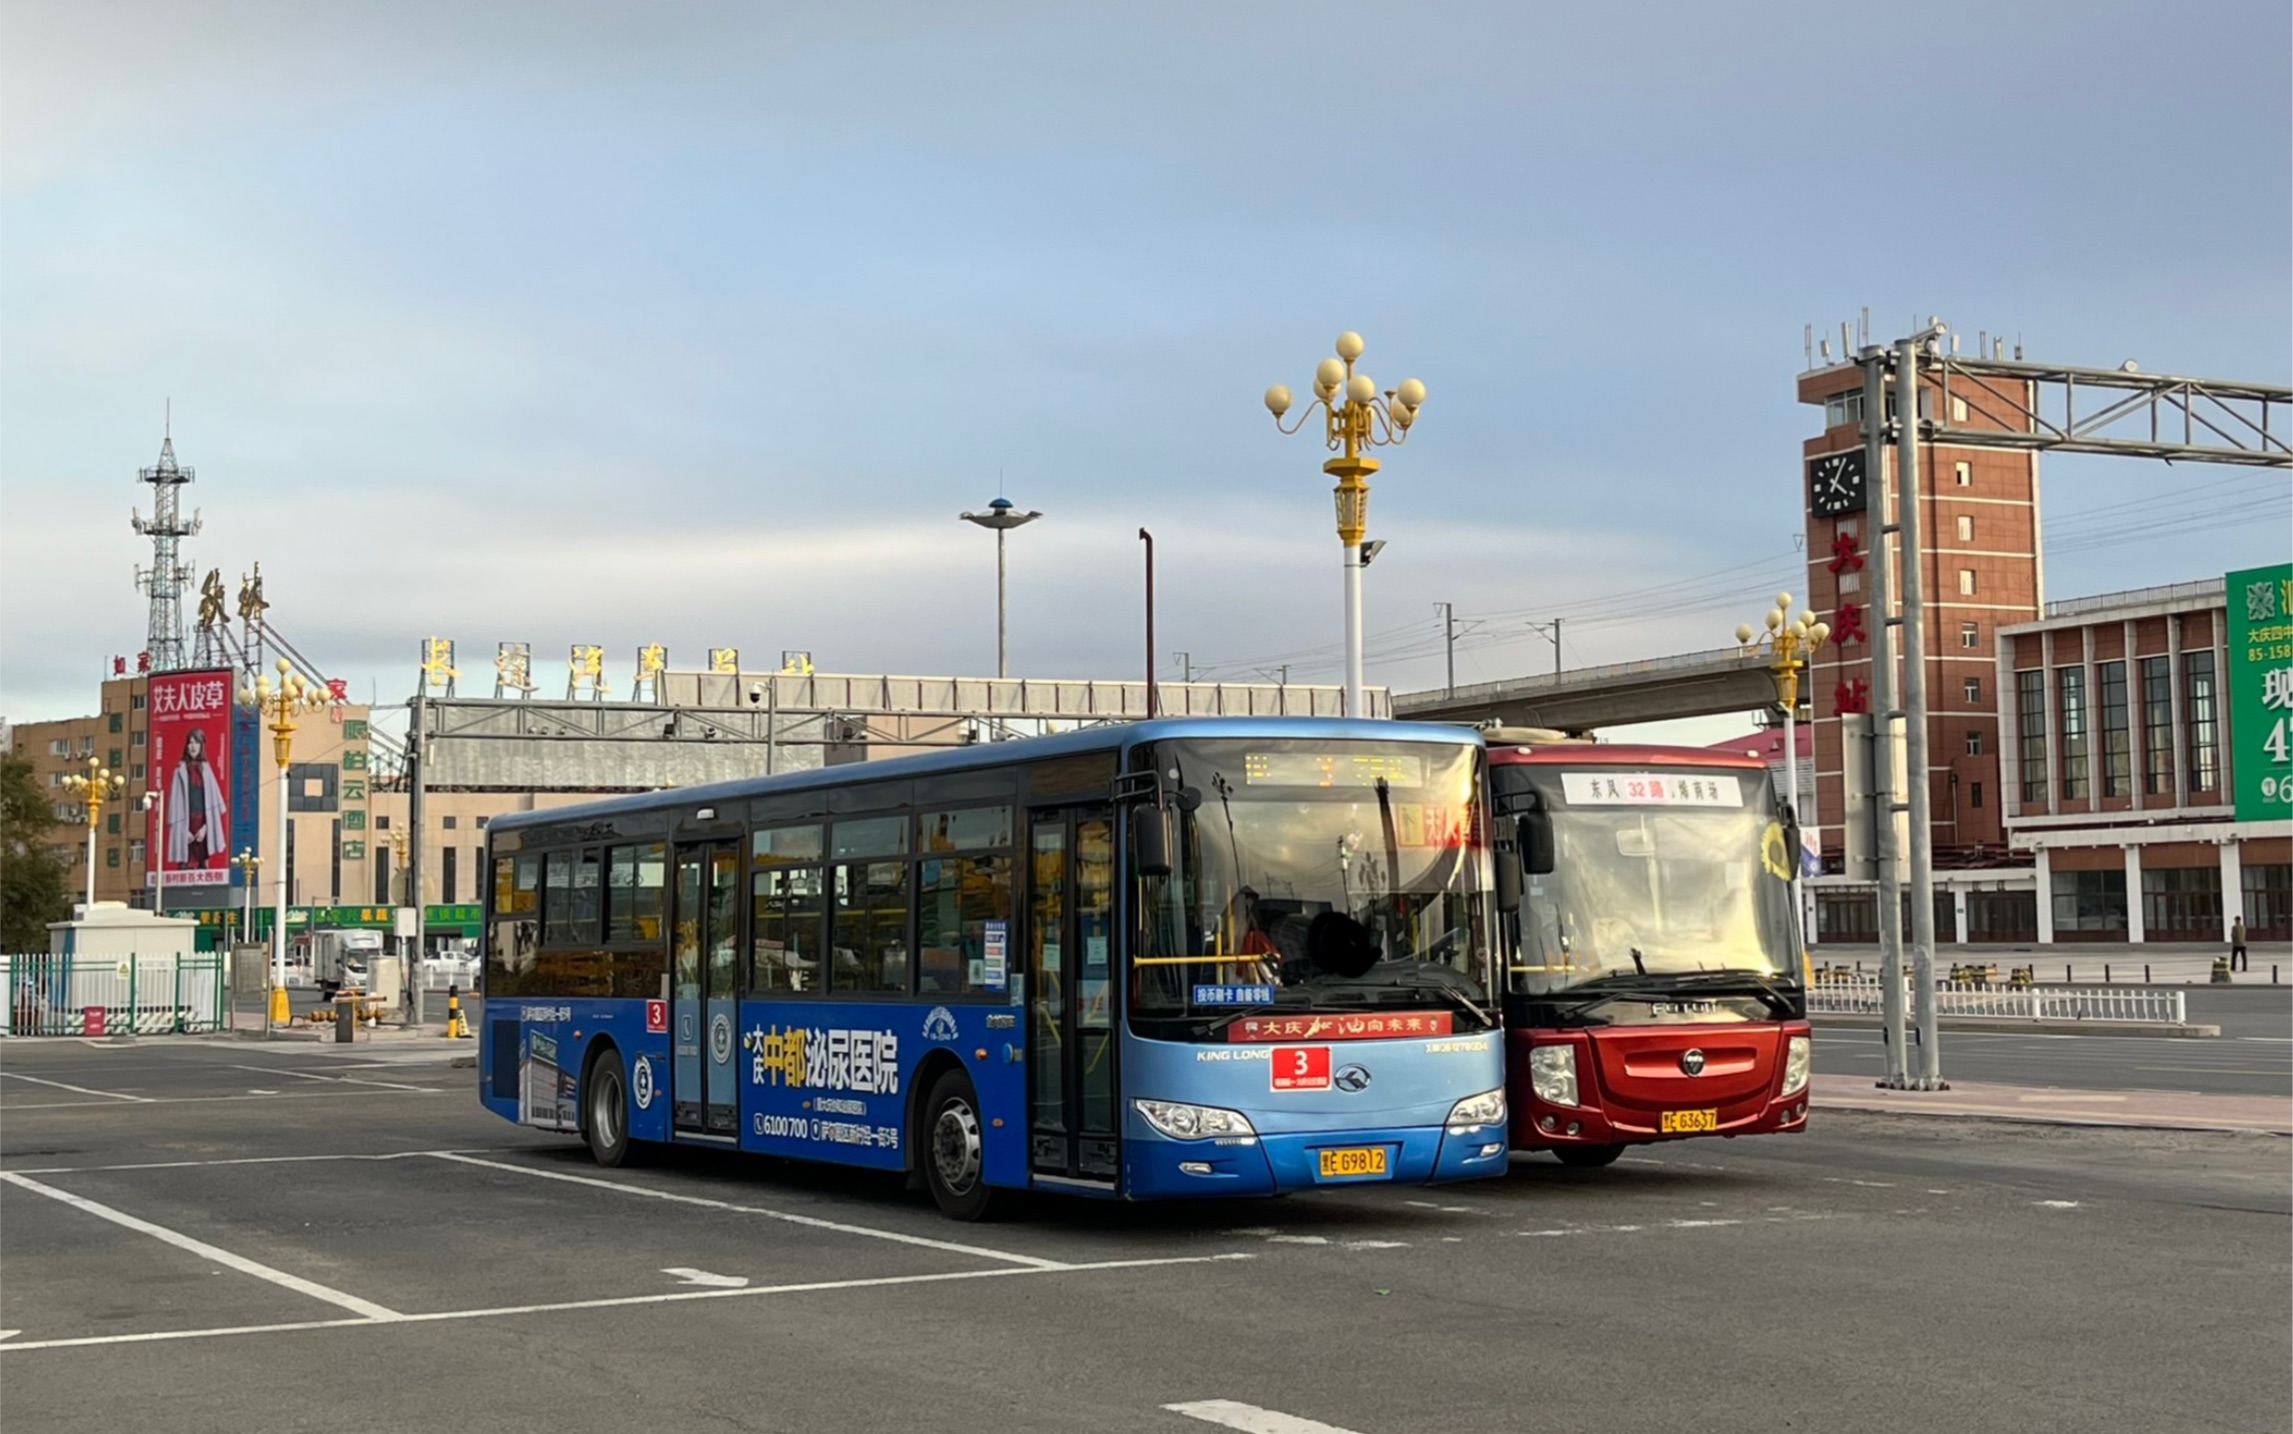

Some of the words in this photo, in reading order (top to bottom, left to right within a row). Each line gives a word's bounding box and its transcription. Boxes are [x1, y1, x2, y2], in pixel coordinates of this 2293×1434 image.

[1828, 532, 1868, 716] 大庆站
[652, 1004, 661, 1024] 3
[1263, 1016, 1423, 1039] 大庆加油向未来
[752, 1024, 765, 1085] 大庆
[764, 1025, 899, 1094] 中都泌尿医院
[1197, 1051, 1230, 1061] KING
[1233, 1049, 1270, 1060] LONG
[1294, 1051, 1308, 1075] 3
[764, 1115, 808, 1139] 6100700
